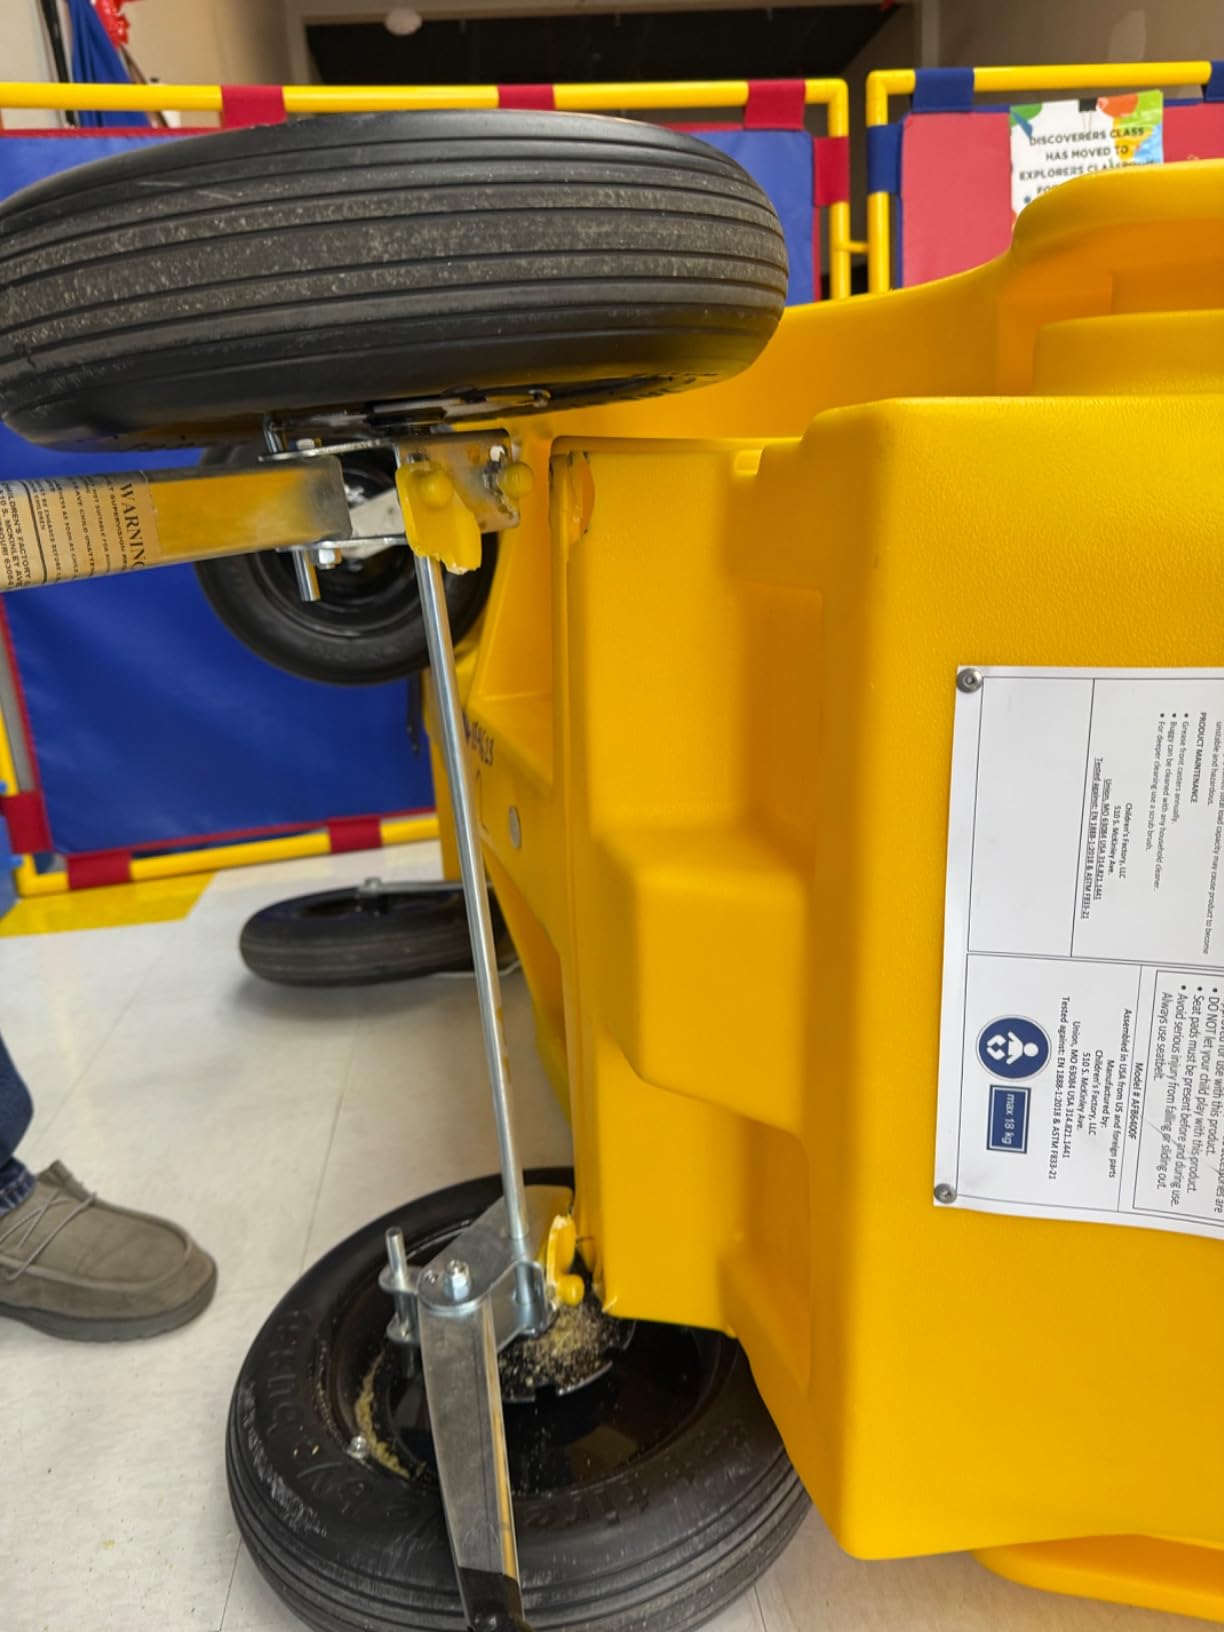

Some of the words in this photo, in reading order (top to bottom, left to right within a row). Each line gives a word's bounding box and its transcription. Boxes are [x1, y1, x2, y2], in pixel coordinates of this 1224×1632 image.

[1030, 130, 1106, 146] DISCOVERERS
[1110, 127, 1145, 139] CLASS
[1046, 151, 1068, 161] HAS
[1072, 148, 1111, 159] MOVED
[1114, 145, 1129, 155] TO
[1020, 166, 1084, 181] EXPLORERS
[110, 494, 126, 552] SUPERVISION
[4, 520, 20, 568] MCKINLEY
[16, 537, 32, 579] FACTORY
[4, 558, 15, 586] 63084
[1167, 721, 1178, 743] Buggy
[1180, 721, 1189, 746] Grease
[1196, 712, 1207, 747] PRODUCT
[1214, 722, 1223, 752] unstable
[1154, 734, 1164, 760] deeper
[1167, 744, 1175, 757] can
[1178, 748, 1187, 766] front
[1094, 758, 1103, 781] Tested
[1166, 758, 1174, 767] be
[1212, 753, 1220, 767] and
[1150, 761, 1162, 790] cleaning
[1163, 769, 1172, 796] cleaned
[1175, 767, 1184, 791] casters
[1190, 749, 1203, 804] MAINTENANCE
[1090, 782, 1101, 810] against:
[1103, 779, 1112, 801] Union,
[1150, 792, 1158, 803] use
[1208, 769, 1218, 807] hazardous.
[1102, 803, 1110, 817] MO
[1113, 806, 1121, 818] 510
[1161, 797, 1170, 812] with
[1171, 793, 1181, 824] annually.
[1090, 811, 1098, 821] EN
[1122, 803, 1133, 838] Children's
[1147, 810, 1157, 829] scrub
[1158, 814, 1166, 826] any
[1100, 818, 1109, 839] 63084
[1086, 822, 1098, 864] 1888-1:2018
[1098, 840, 1107, 854] USA
[1108, 828, 1119, 859] McKinley
[1146, 830, 1154, 851] brush.
[1156, 828, 1166, 863] household
[1213, 826, 1223, 854] capacity
[1118, 838, 1129, 866] Factory,
[1108, 860, 1116, 875] Ave.
[1118, 867, 1127, 879] LLC
[1211, 856, 1220, 871] may
[1084, 872, 1093, 892] ASTM
[1094, 856, 1106, 901] 314.821.1441
[1154, 864, 1163, 891] cleaner.
[1081, 894, 1091, 919] F833-21
[1206, 892, 1215, 918] product
[1203, 928, 1212, 954] become
[1060, 996, 1070, 1023] Tested
[1158, 992, 1173, 1024] Always
[1175, 993, 1188, 1020] Avoid
[1192, 995, 1204, 1015] Seat
[1208, 996, 1220, 1012] DO
[1070, 1022, 1081, 1047] Union,
[1120, 1009, 1132, 1052] Assembled
[1158, 1026, 1168, 1042] use
[1188, 1017, 1201, 1038] pads
[1205, 1013, 1218, 1035] NOT
[1057, 1025, 1068, 1055] against:
[1172, 1022, 1185, 1053] serious
[1203, 1036, 1216, 1049] let
[1056, 1057, 1066, 1068] EN
[1070, 1049, 1079, 1064] MO
[1082, 1052, 1091, 1067] 510
[1120, 1054, 1129, 1062] in
[1153, 1044, 1166, 1081] seatbelt.
[1186, 1040, 1198, 1063] must
[1200, 1050, 1212, 1072] your
[1068, 1065, 1077, 1089] 63084
[1092, 1050, 1104, 1088] Children's
[1118, 1064, 1128, 1080] USA
[1133, 1062, 1144, 1090] Model
[1167, 1055, 1182, 1080] injury
[1184, 1064, 1197, 1076] be
[1216, 1060, 1224, 1077] use
[1053, 1070, 1065, 1117] 1888-1:2018
[1077, 1078, 1089, 1112] McKinley
[1102, 1060, 1115, 1115] Manufactured
[1116, 1081, 1126, 1101] from
[1166, 1082, 1180, 1104] from
[1181, 1078, 1194, 1112] present
[1198, 1073, 1211, 1095] child
[1213, 1079, 1224, 1098] with
[1006, 1094, 1015, 1115] max
[1066, 1090, 1075, 1107] USA
[1088, 1090, 1100, 1121] Factory,
[1114, 1102, 1123, 1113] US
[1194, 1097, 1209, 1116] play
[1210, 1101, 1223, 1117] this
[1004, 1118, 1015, 1130] 18
[1076, 1114, 1086, 1131] Ave.
[1088, 1122, 1097, 1136] LLC
[1100, 1116, 1110, 1128] by:
[1113, 1114, 1121, 1129] and
[1128, 1098, 1140, 1141] AFB6400F
[1160, 1106, 1177, 1132] falling
[1178, 1113, 1192, 1141] before
[1192, 1118, 1205, 1137] with
[1001, 1132, 1015, 1145] kg
[1050, 1126, 1060, 1149] ASTM
[1062, 1108, 1074, 1158] 314.821.1441
[1109, 1130, 1121, 1157] foreign
[1162, 1133, 1172, 1143] or
[1206, 1119, 1219, 1157] product.
[1156, 1144, 1172, 1172] sliding
[1176, 1143, 1187, 1160] and
[1191, 1140, 1203, 1156] this
[1048, 1150, 1059, 1180] F833-21
[1108, 1159, 1118, 1178] parts
[1170, 1161, 1186, 1189] during
[1187, 1157, 1200, 1193] product.
[1156, 1173, 1167, 1189] out.
[1170, 1190, 1181, 1207] use.
[1214, 1198, 1223, 1213] are
